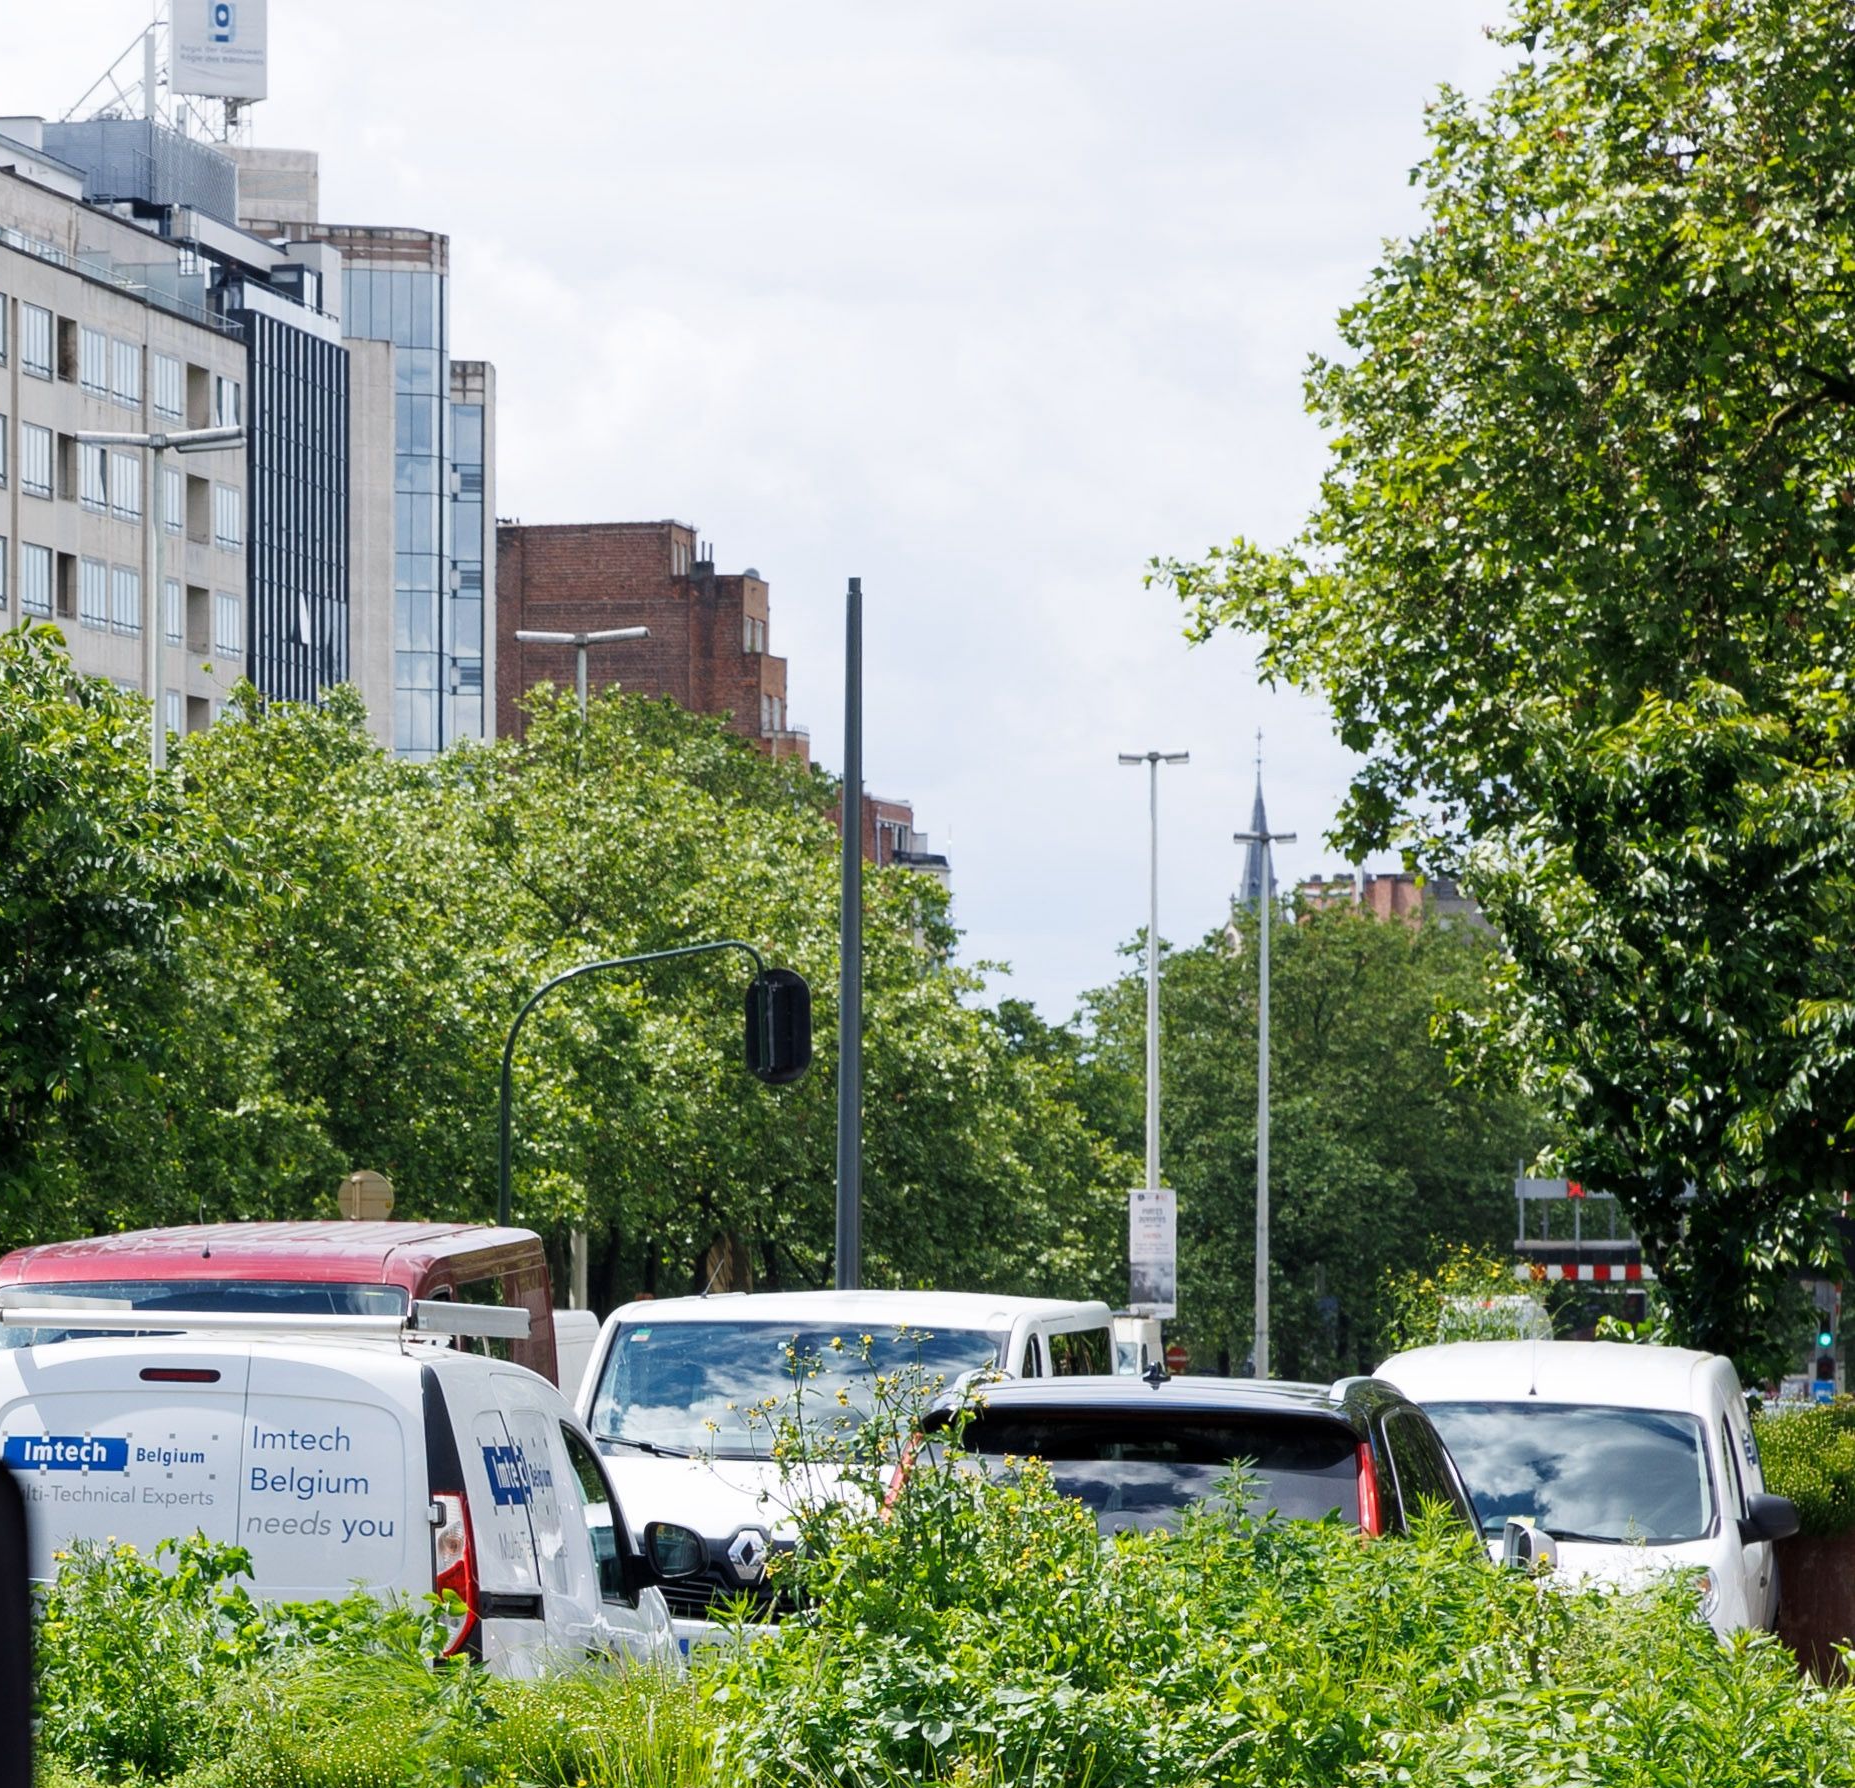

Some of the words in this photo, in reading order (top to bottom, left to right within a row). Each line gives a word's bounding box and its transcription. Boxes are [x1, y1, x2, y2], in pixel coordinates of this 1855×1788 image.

[251, 1425, 351, 1453] Imtech
[24, 1440, 107, 1463] Imtech
[136, 1447, 205, 1467] Belgium
[22, 1483, 135, 1505] lti-Technical
[143, 1487, 214, 1508] Experts
[250, 1467, 370, 1500] Belgium
[246, 1509, 332, 1538] needs
[340, 1515, 394, 1543] you
